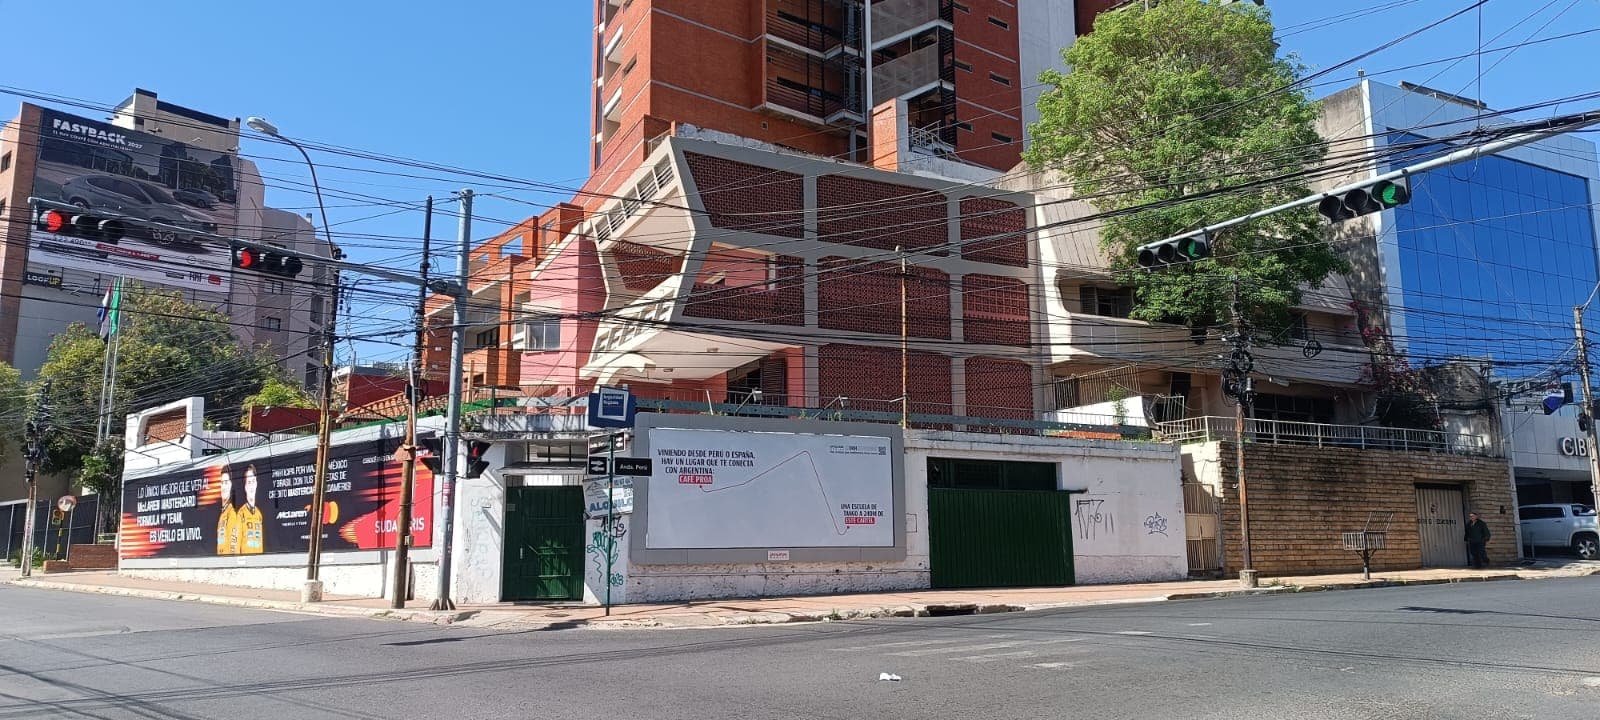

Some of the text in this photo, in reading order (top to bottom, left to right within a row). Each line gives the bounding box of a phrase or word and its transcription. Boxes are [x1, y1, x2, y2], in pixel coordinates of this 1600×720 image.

[52, 118, 126, 145] FASTBACK
[688, 449, 706, 458] DESDE
[708, 450, 723, 458] PERÚ
[296, 466, 306, 474] POR
[328, 459, 348, 470] MÉXICO
[665, 466, 677, 474] CON
[685, 458, 705, 466] LUGAR
[729, 459, 754, 467] CONECTA
[276, 479, 292, 488] BRASIL
[304, 476, 314, 484] TUS
[340, 471, 347, 480] DE
[145, 484, 160, 498] ÚNICO
[160, 482, 178, 495] MEJOR
[179, 481, 190, 494] QUE
[191, 479, 202, 491] VER
[161, 496, 196, 510] MASTERCARD
[276, 510, 308, 520] McLaren
[375, 517, 425, 534] SUDARIS
[150, 526, 202, 542] ES VERLO EN VIVO.
